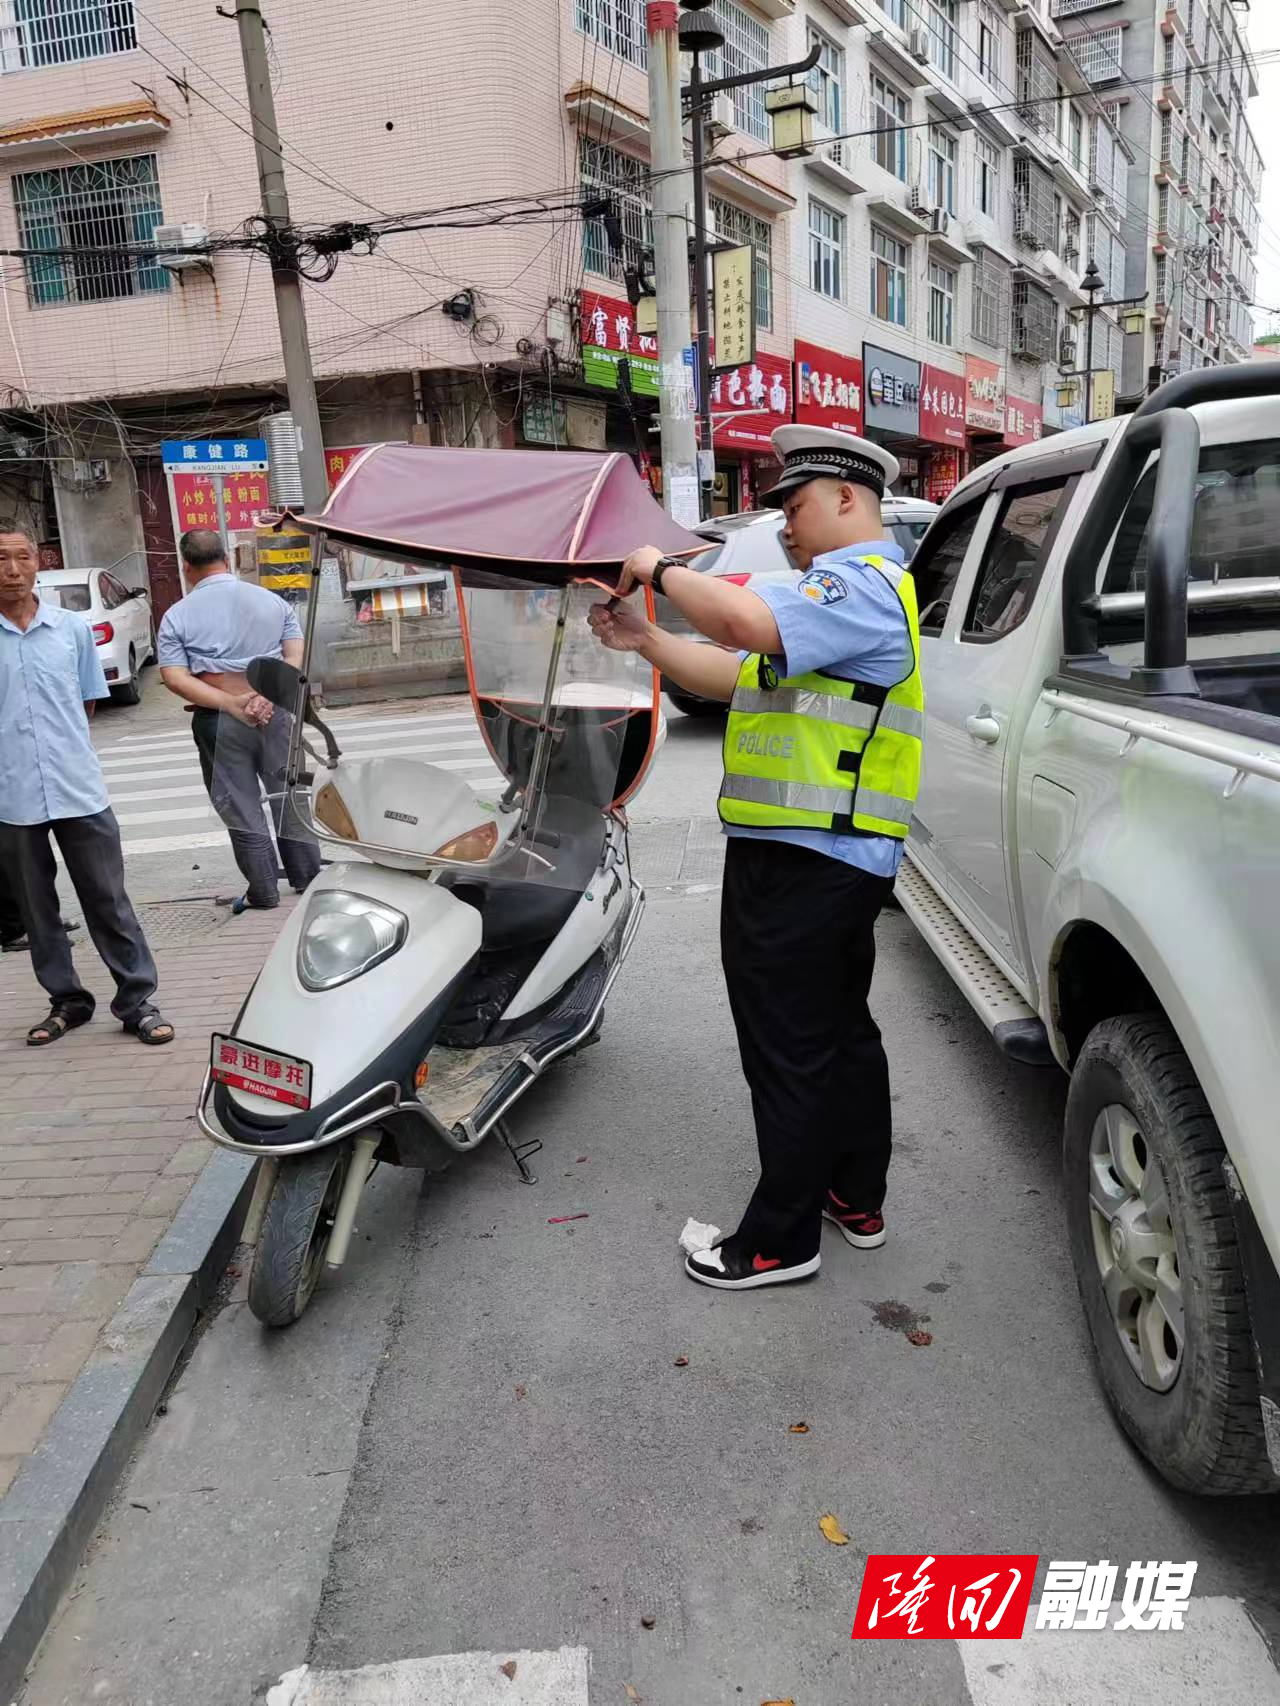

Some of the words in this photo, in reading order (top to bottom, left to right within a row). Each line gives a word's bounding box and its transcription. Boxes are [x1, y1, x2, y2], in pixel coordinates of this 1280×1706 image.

[183, 443, 248, 460] 康健路
[737, 732, 797, 758] POLICE
[220, 1044, 304, 1087] 豪进摩托
